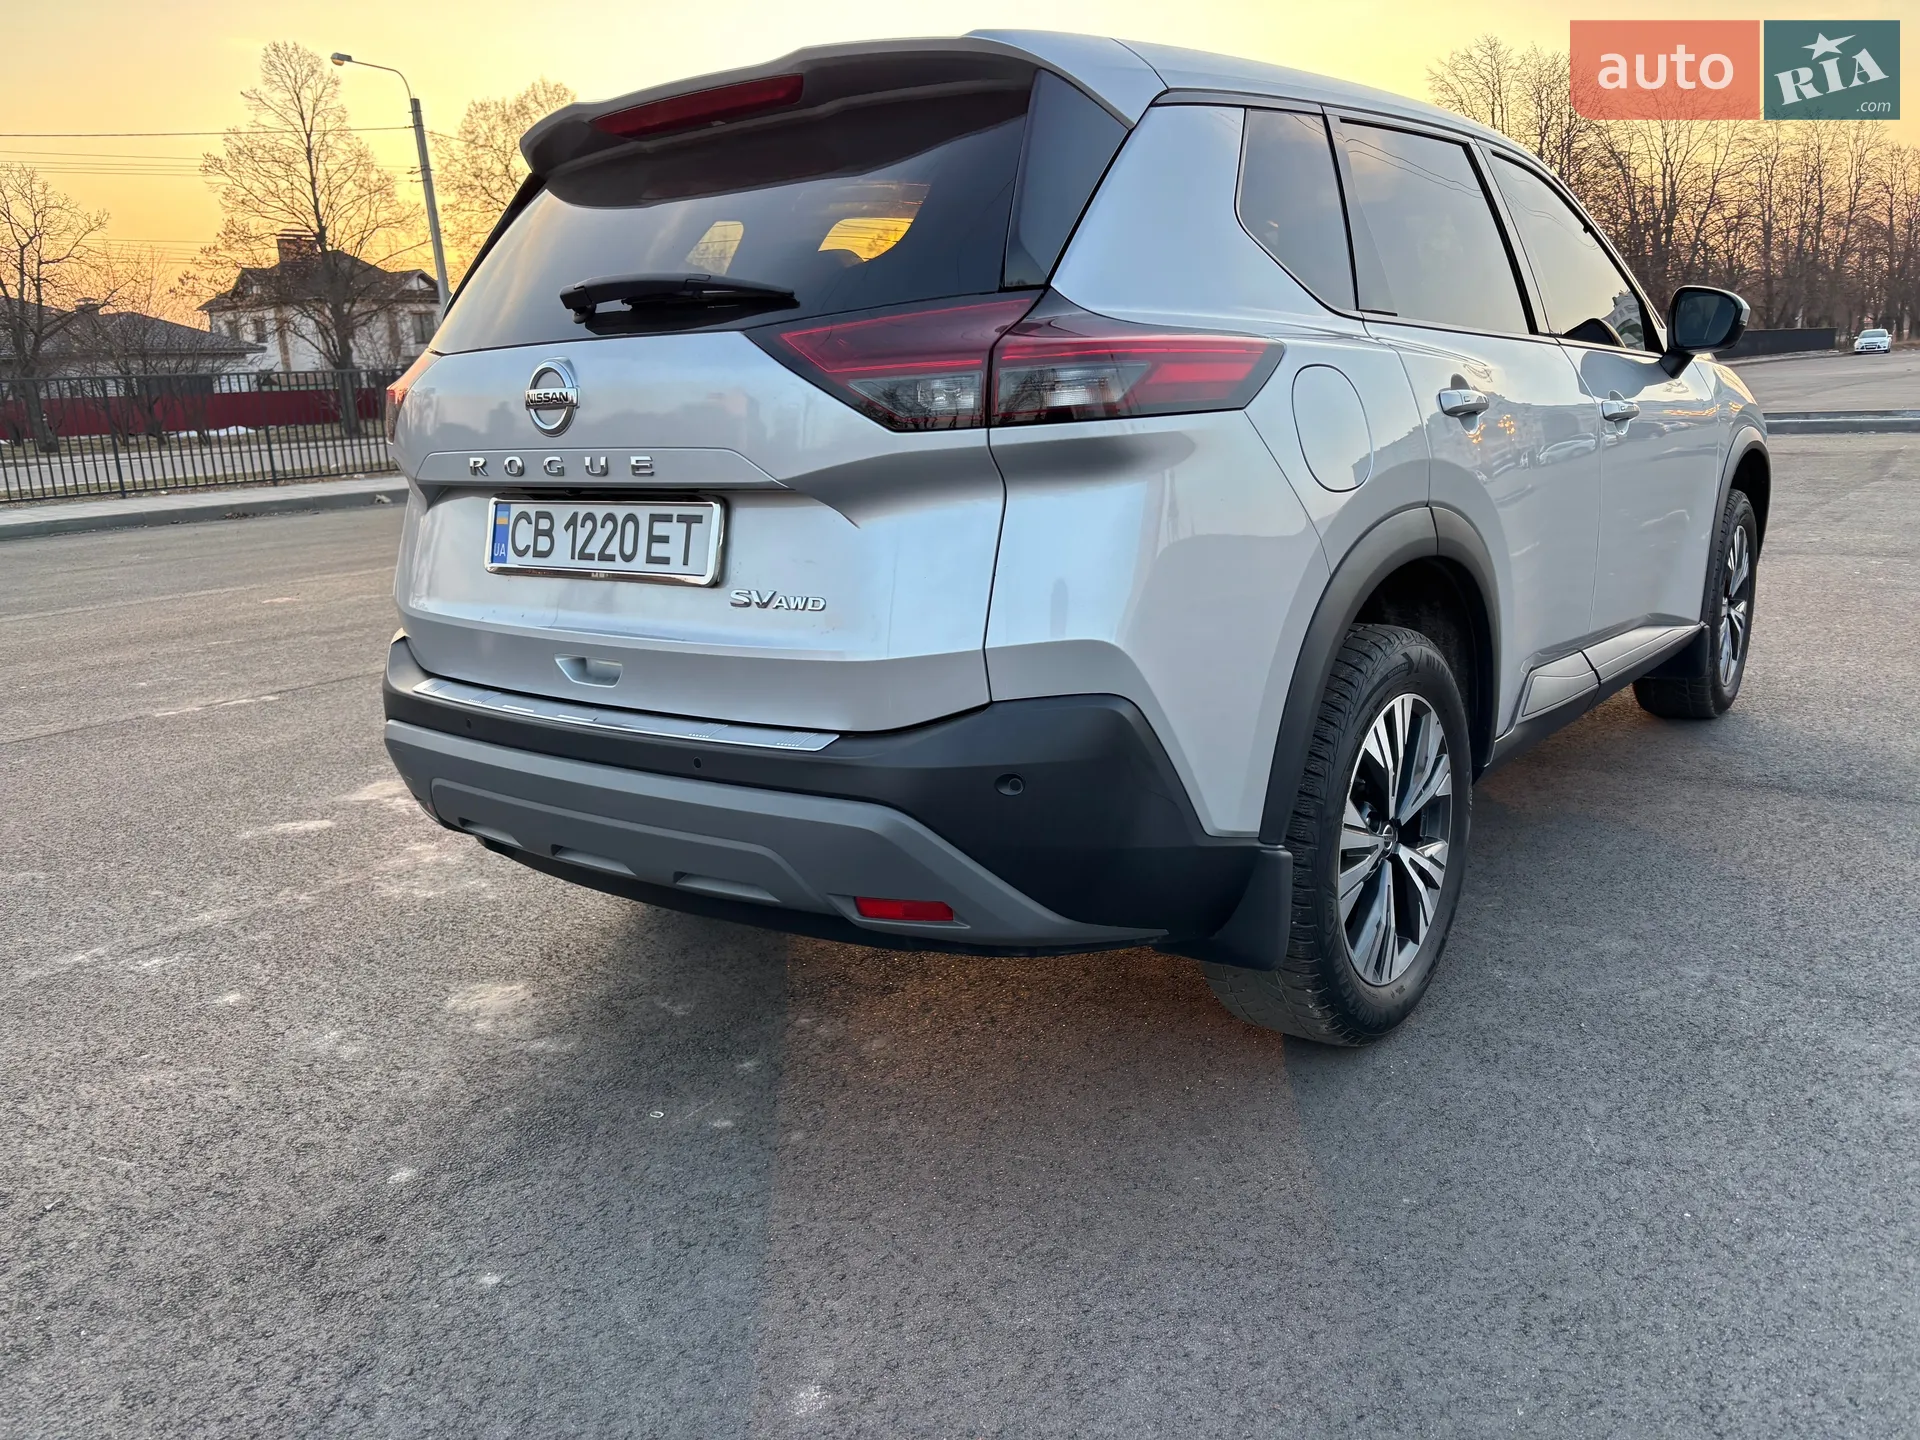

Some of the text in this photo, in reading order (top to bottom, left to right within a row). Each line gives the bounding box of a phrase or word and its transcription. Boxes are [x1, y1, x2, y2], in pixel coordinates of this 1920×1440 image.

[526, 391, 569, 405] NISSAN
[468, 455, 656, 477] ROGUE
[493, 543, 507, 558] UA
